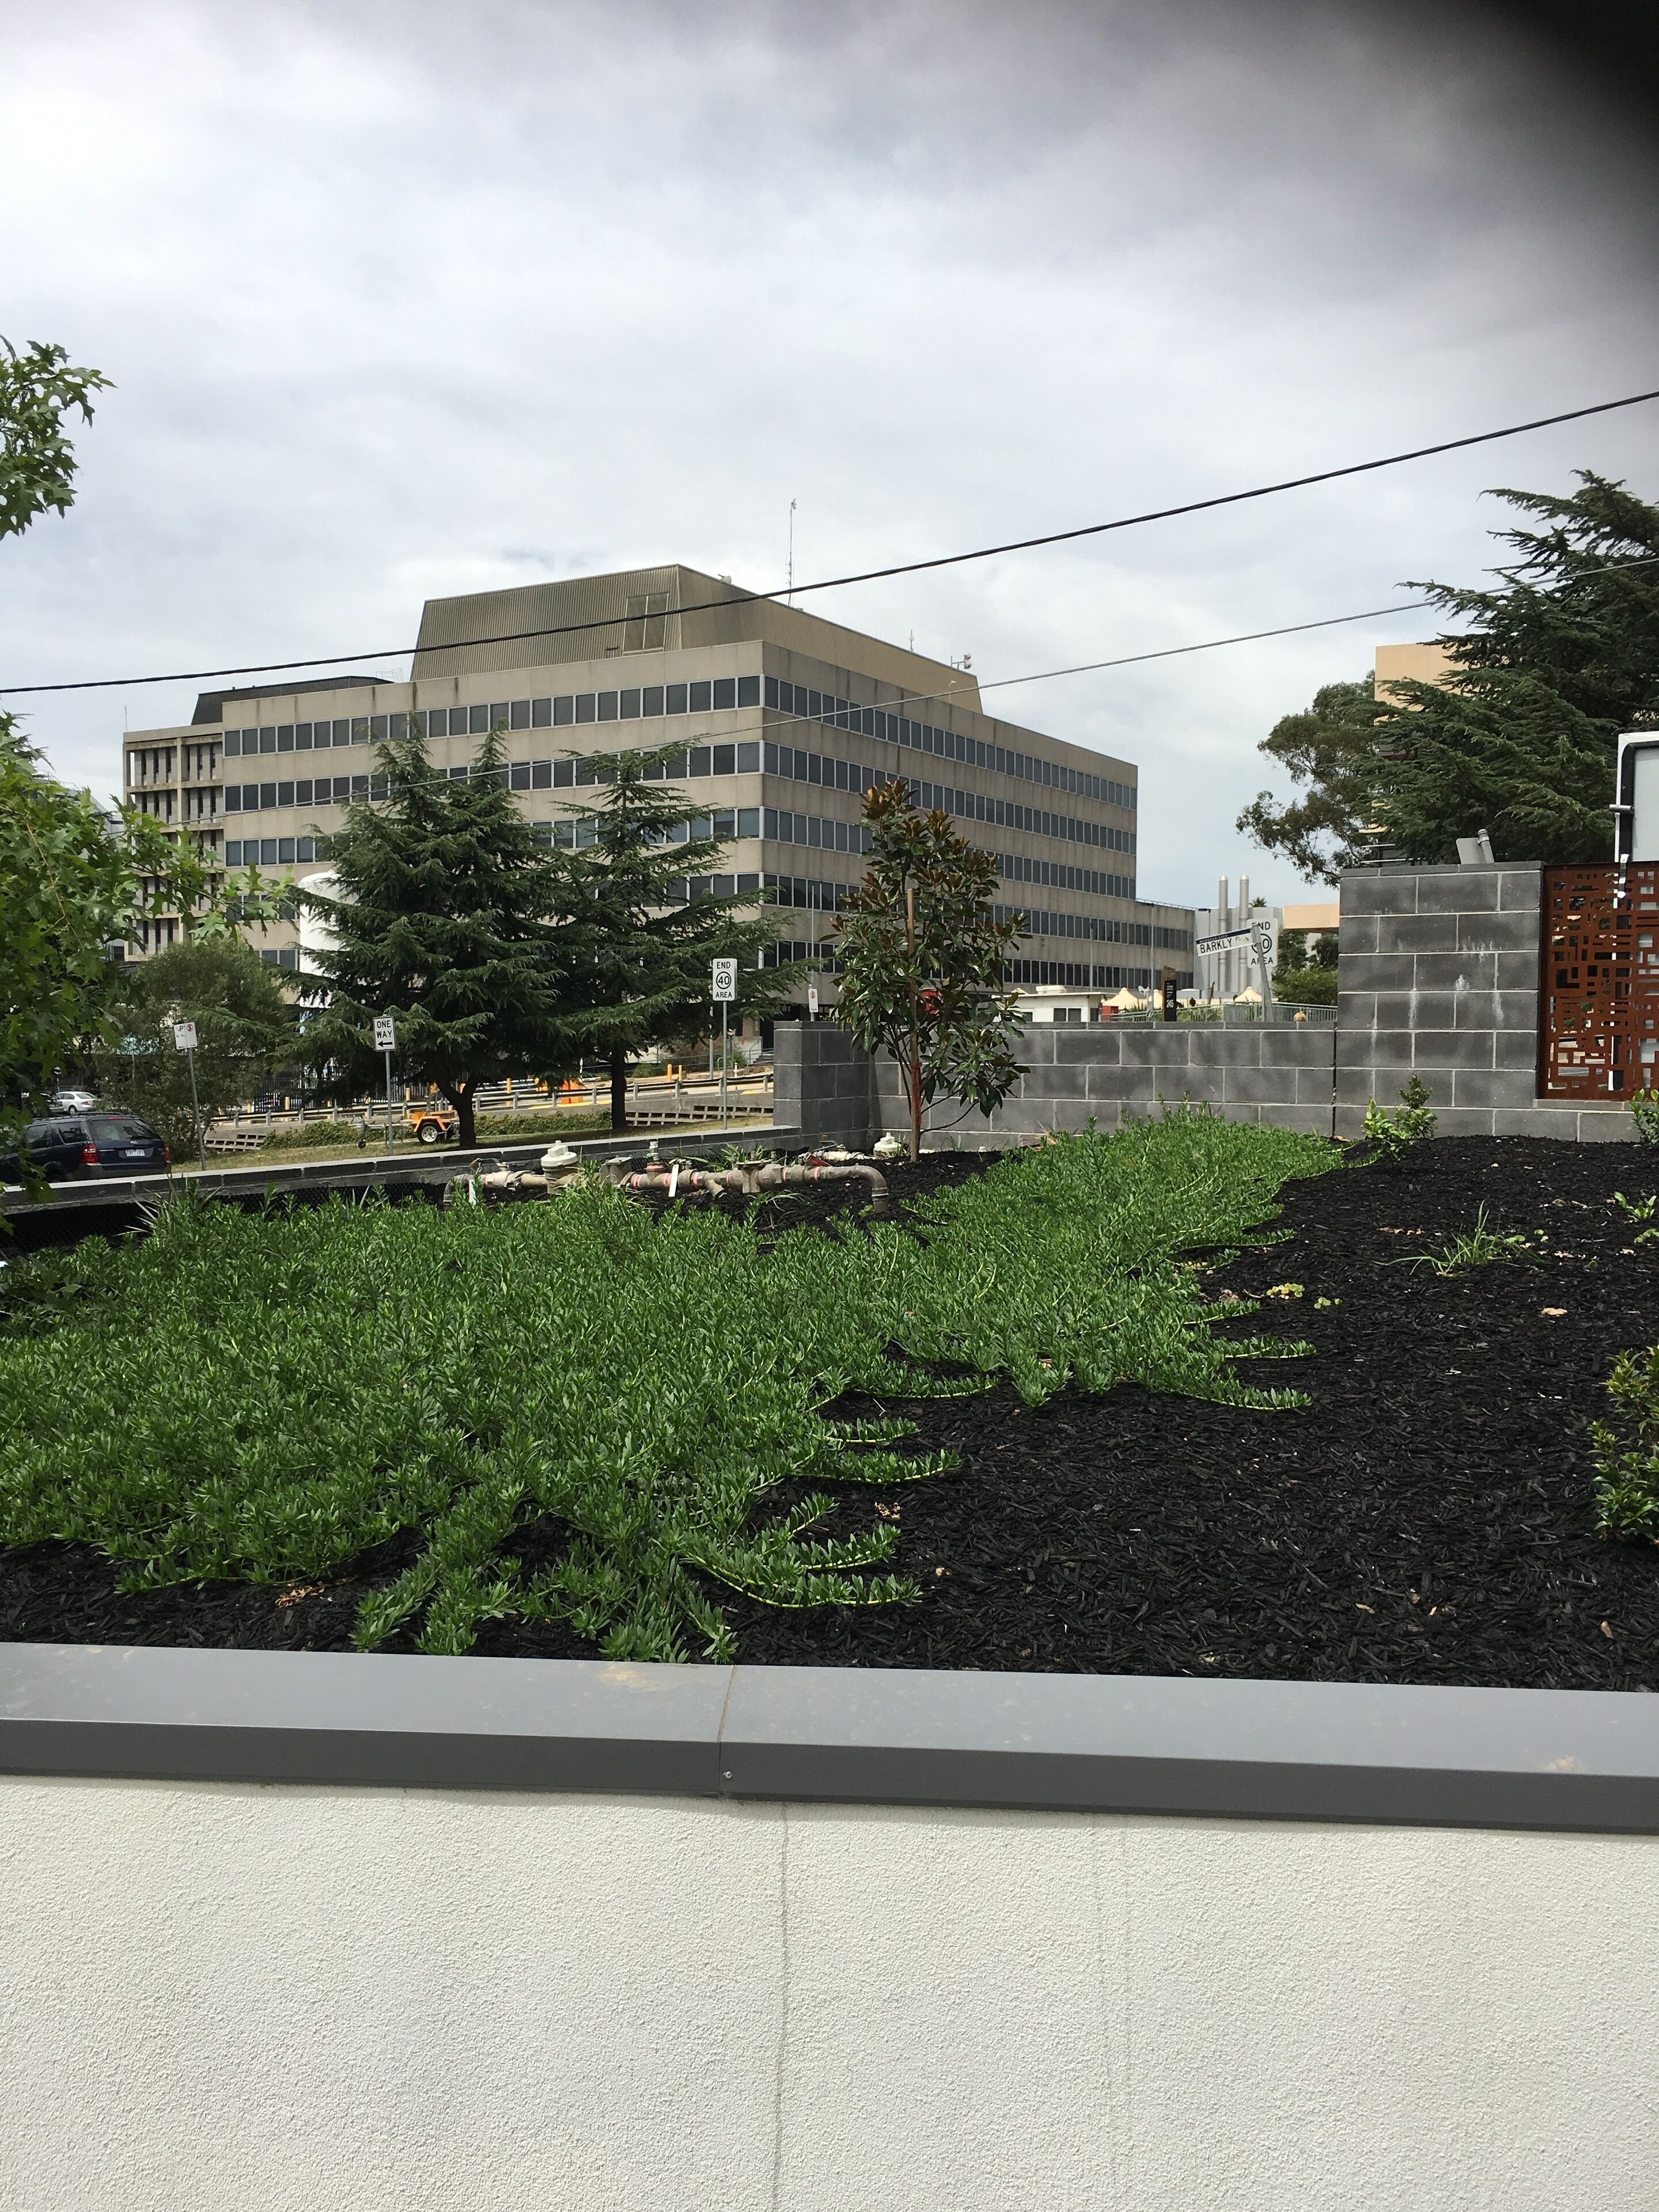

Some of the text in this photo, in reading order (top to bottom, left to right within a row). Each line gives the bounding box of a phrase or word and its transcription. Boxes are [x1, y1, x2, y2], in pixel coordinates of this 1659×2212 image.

[1252, 922, 1271, 930] ND
[1200, 938, 1232, 953] BARKLY
[1253, 938, 1270, 949] 0
[1251, 957, 1274, 965] AEA
[718, 976, 730, 985] 40
[377, 1020, 391, 1028] ONE
[376, 1031, 392, 1039] WAY
